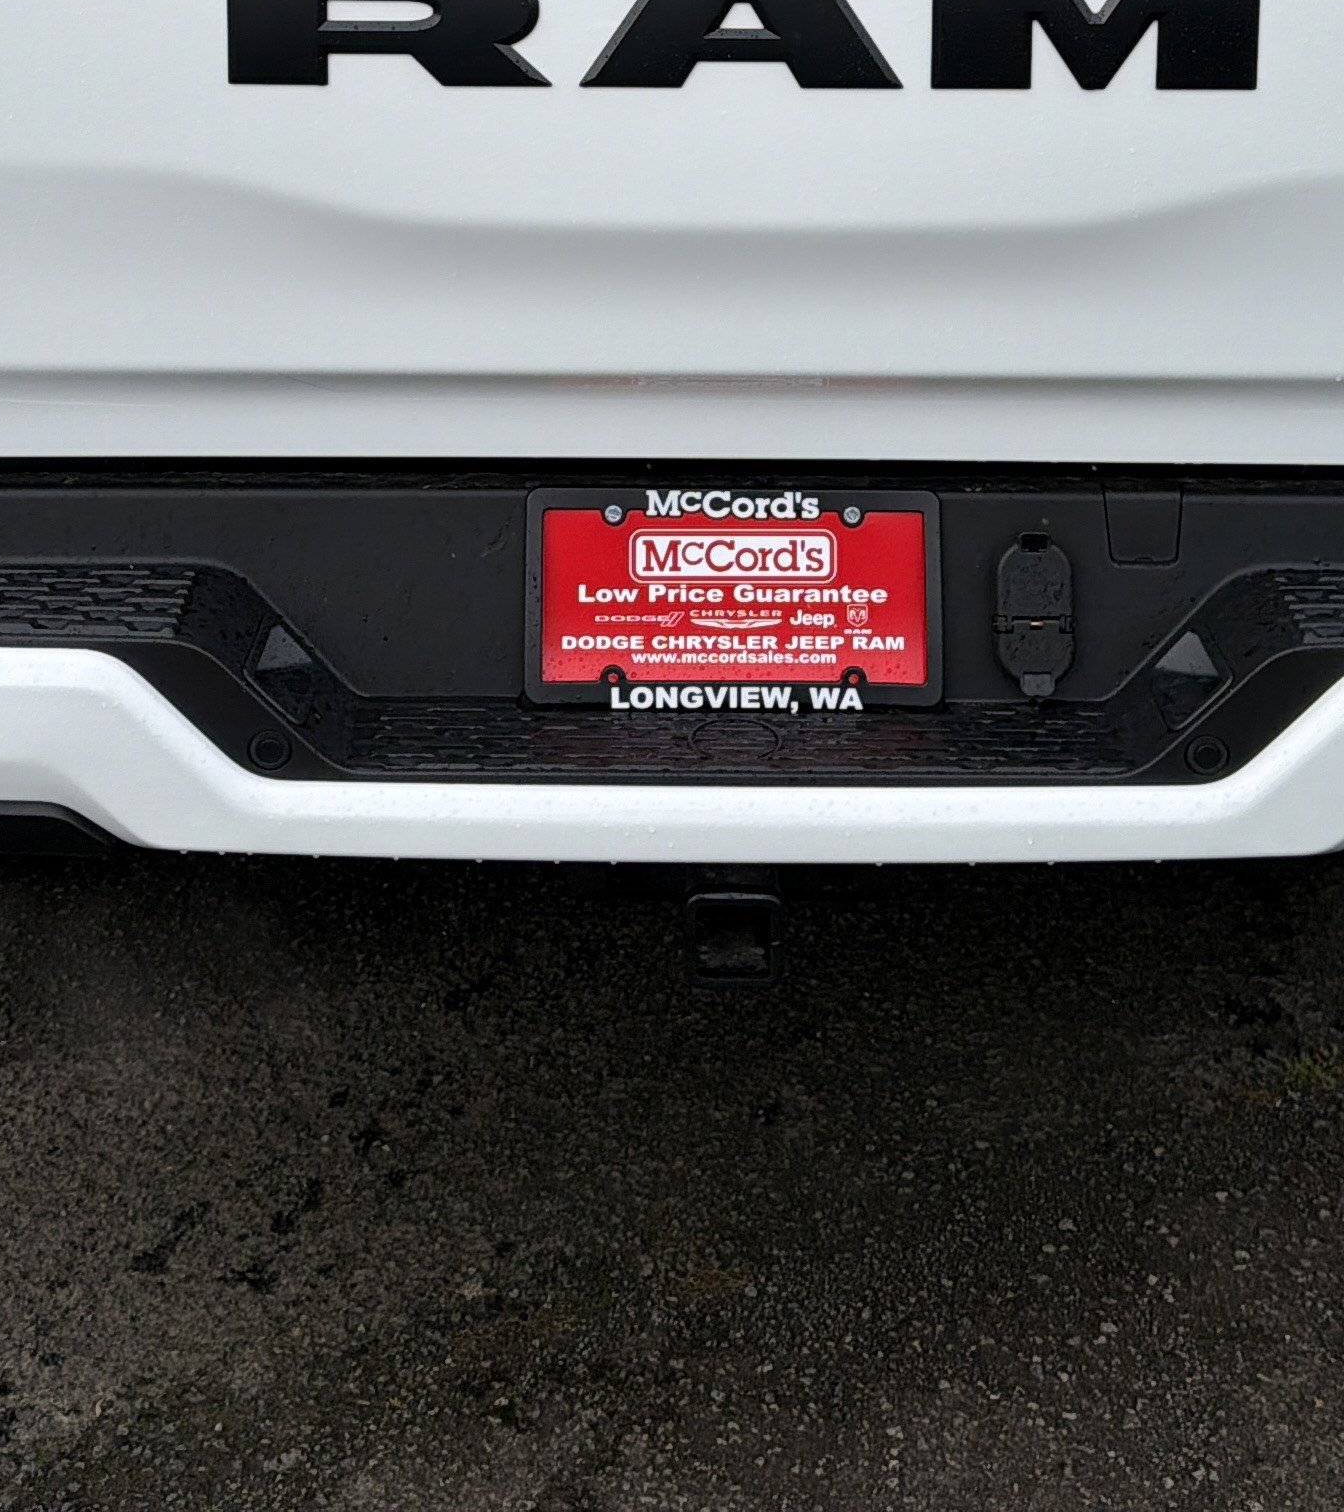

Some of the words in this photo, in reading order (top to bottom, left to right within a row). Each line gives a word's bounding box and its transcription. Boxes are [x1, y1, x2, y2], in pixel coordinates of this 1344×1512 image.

[644, 489, 820, 519] McCord's
[641, 539, 825, 573] McCord's
[578, 584, 638, 603] Low
[648, 584, 724, 603] Price
[733, 584, 888, 604] Guarantee
[689, 609, 783, 618] CHRYSLER
[789, 609, 836, 628] Jeep
[561, 635, 645, 650] DODGE
[652, 635, 779, 650] CHRYSLER
[785, 635, 845, 651] JEEP
[852, 636, 905, 651] RAM
[631, 650, 837, 664] www.mccordsales.com
[610, 686, 799, 714] LONGVIEW,
[809, 686, 864, 711] WA
